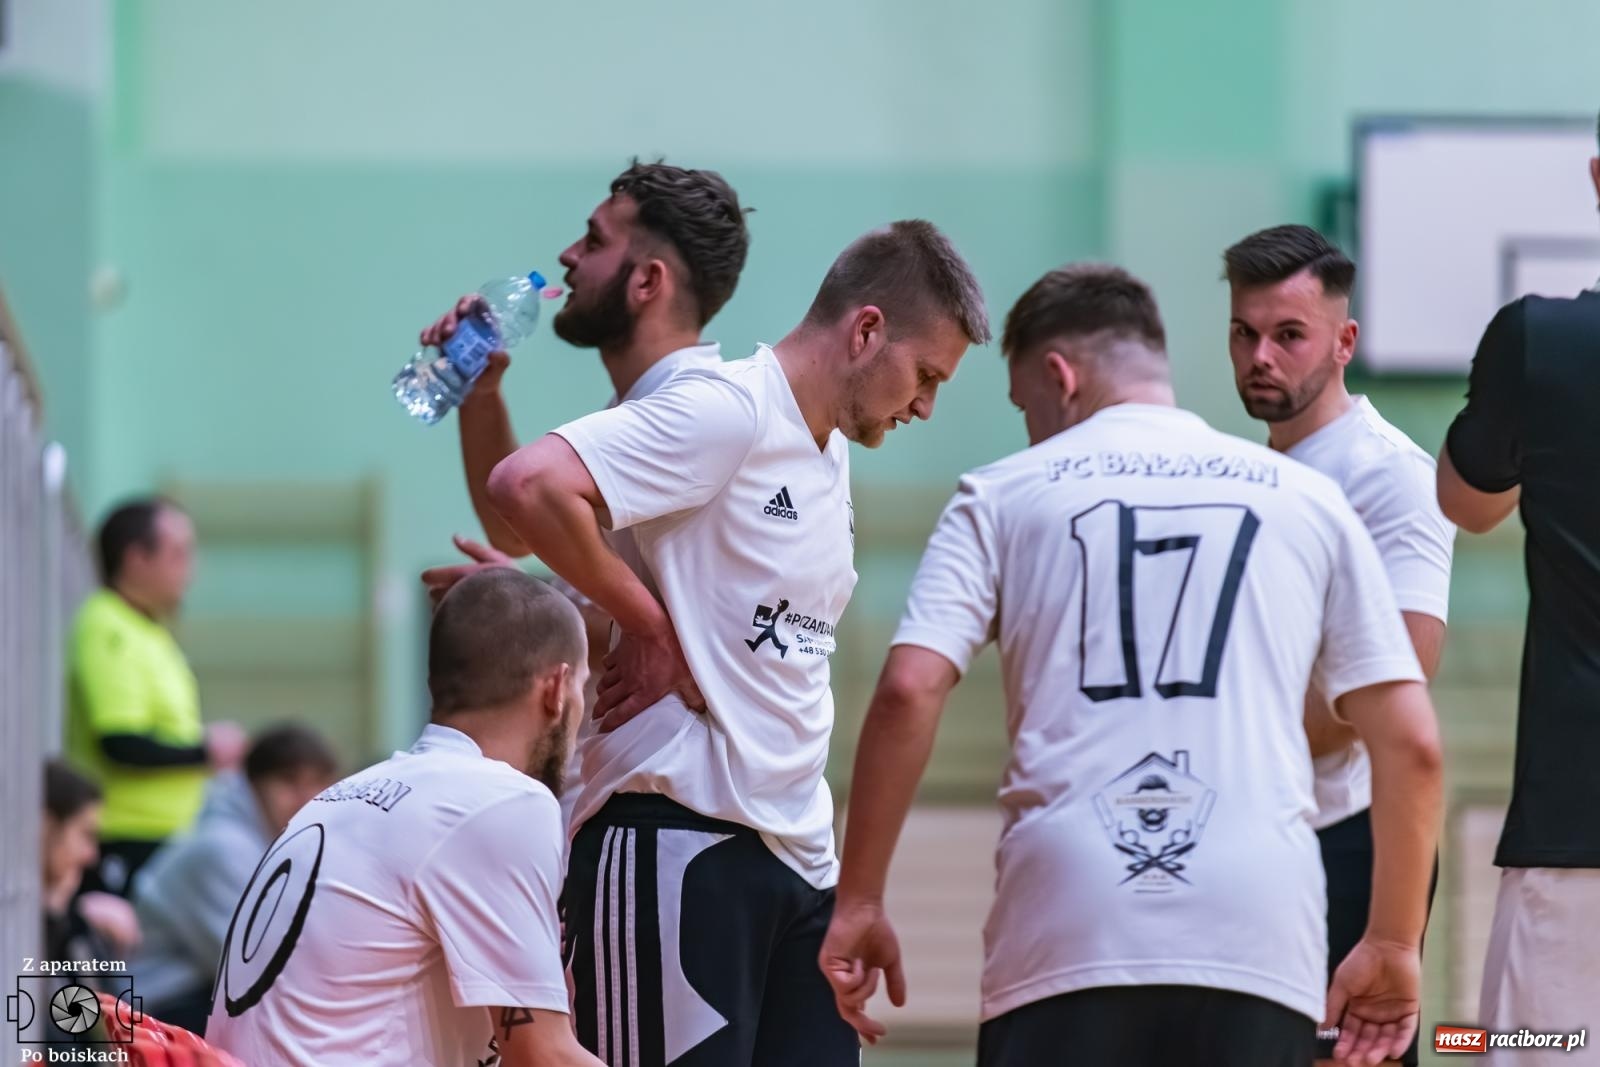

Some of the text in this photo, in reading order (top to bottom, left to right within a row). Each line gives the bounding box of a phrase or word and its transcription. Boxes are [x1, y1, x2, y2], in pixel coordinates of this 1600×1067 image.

[1046, 455, 1094, 482] FC
[763, 505, 798, 521] adidas
[1071, 498, 1262, 704] 17
[799, 646, 814, 655] +48
